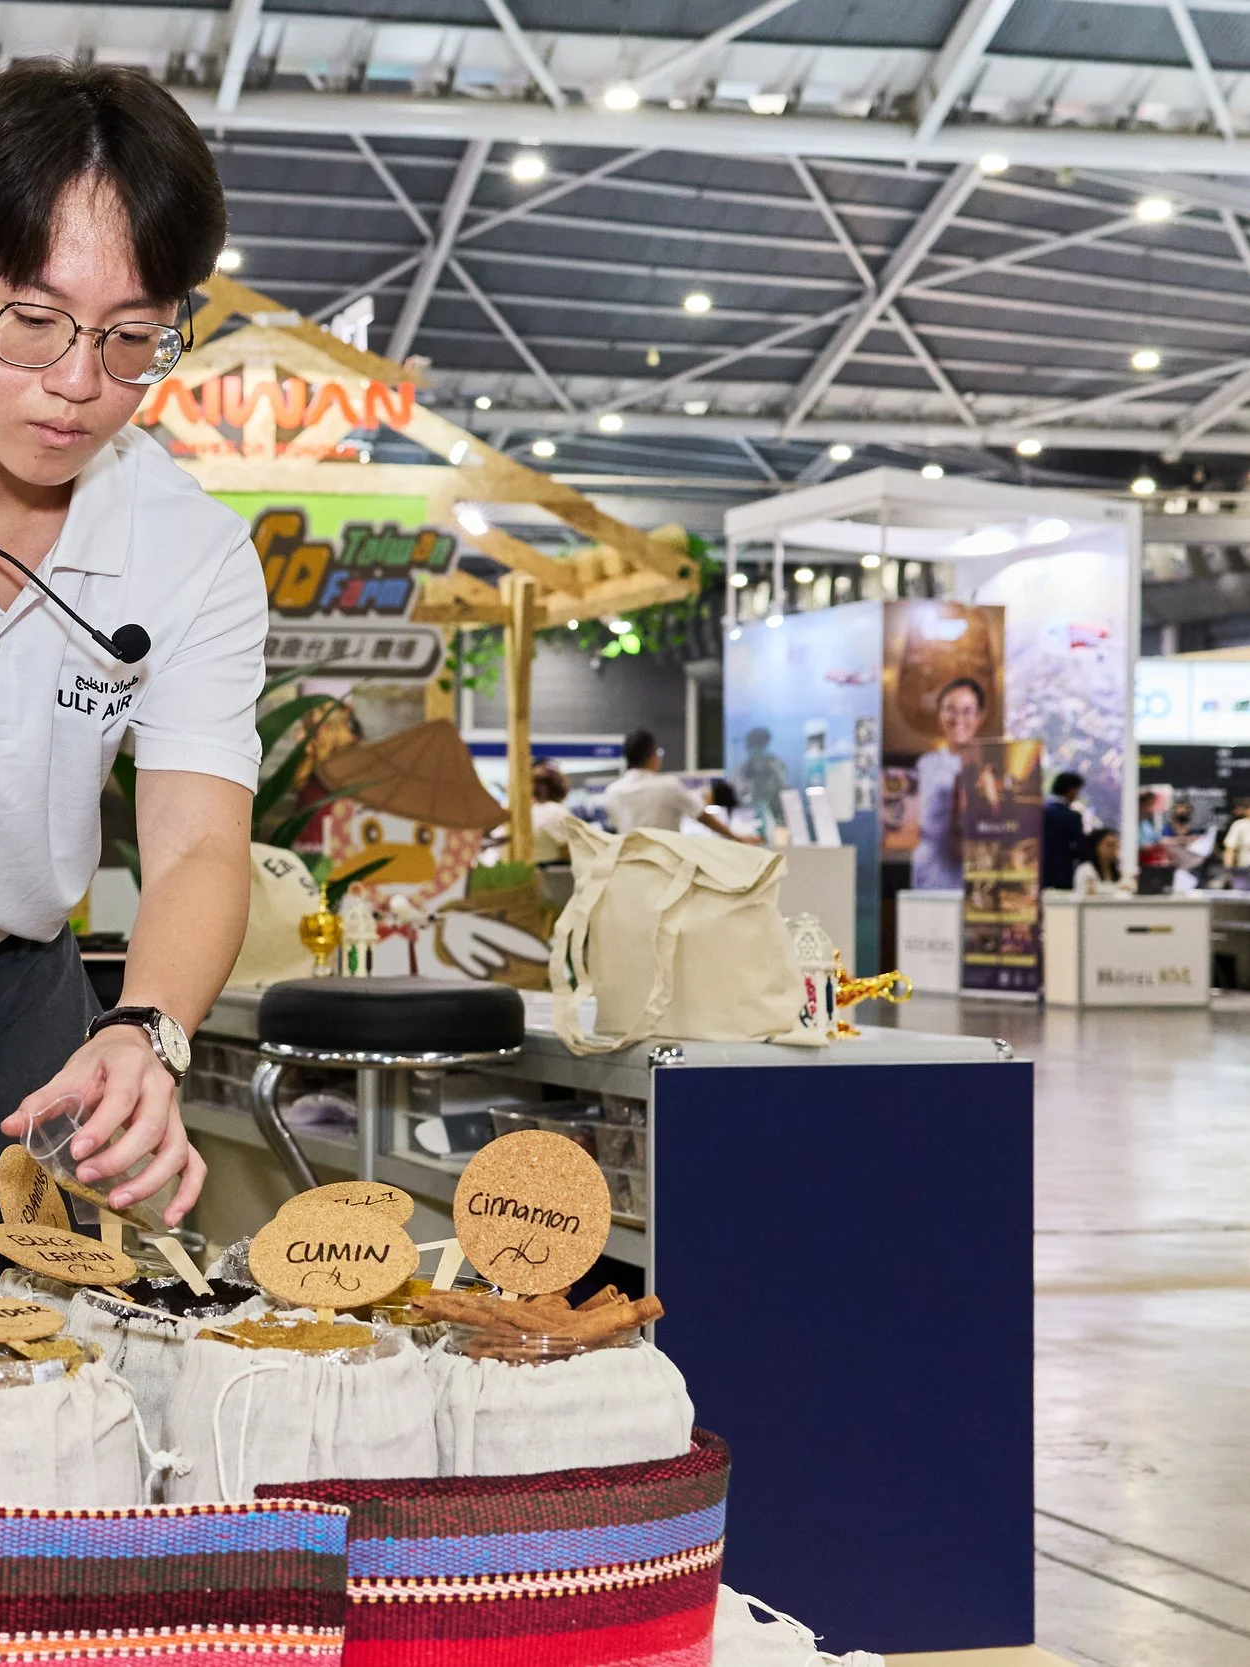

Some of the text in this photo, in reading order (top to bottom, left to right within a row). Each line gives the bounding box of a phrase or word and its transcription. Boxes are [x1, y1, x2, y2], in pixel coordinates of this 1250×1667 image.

[133, 375, 415, 431] AIWAN
[75, 675, 139, 694] طيران الخليج
[57, 689, 133, 721] ULF AIR
[468, 1191, 581, 1235] Cinnamon
[36, 1250, 115, 1262] LEMON
[286, 1240, 390, 1264] CUMIN
